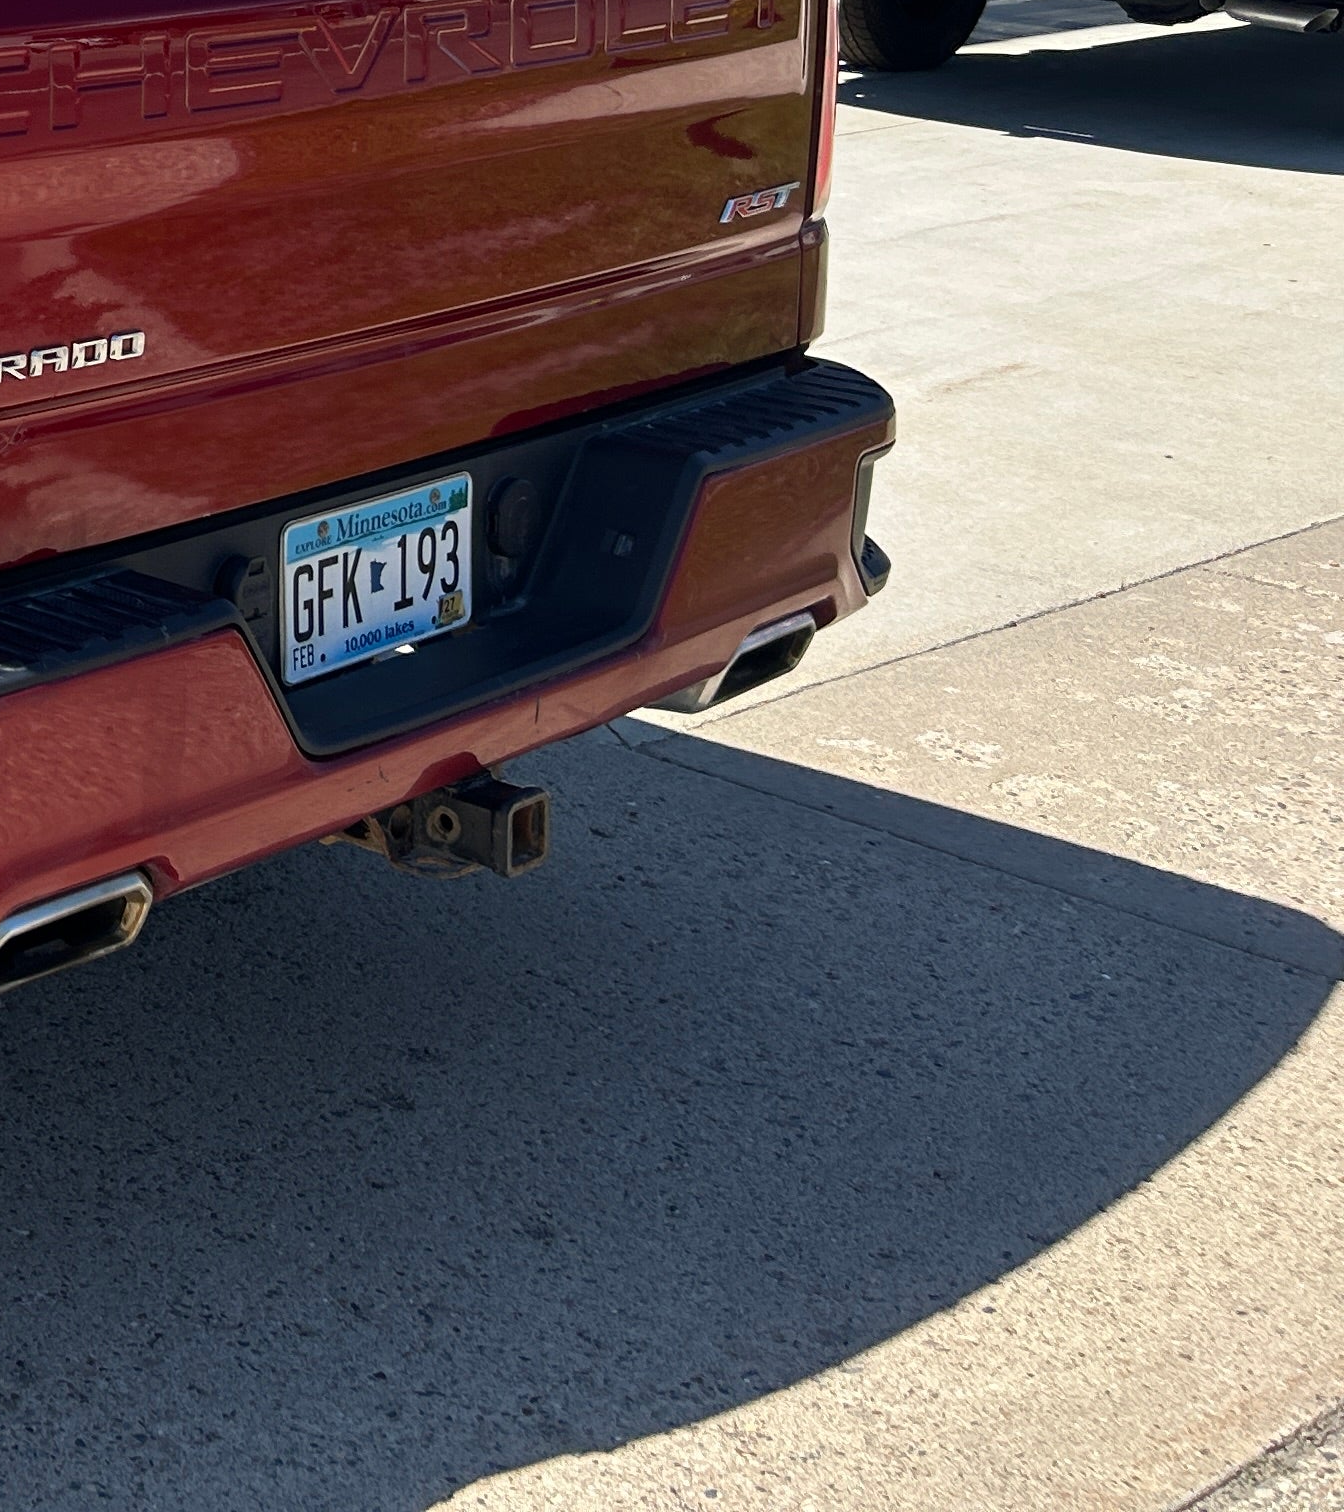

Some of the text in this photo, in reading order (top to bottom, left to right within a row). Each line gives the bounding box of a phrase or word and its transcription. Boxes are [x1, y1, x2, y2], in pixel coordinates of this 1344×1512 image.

[719, 181, 801, 223] RST
[295, 535, 333, 556] EXPLORE
[293, 520, 460, 644] GFK 193
[343, 619, 415, 654] 10,000 lakes
[292, 643, 315, 672] FEB
